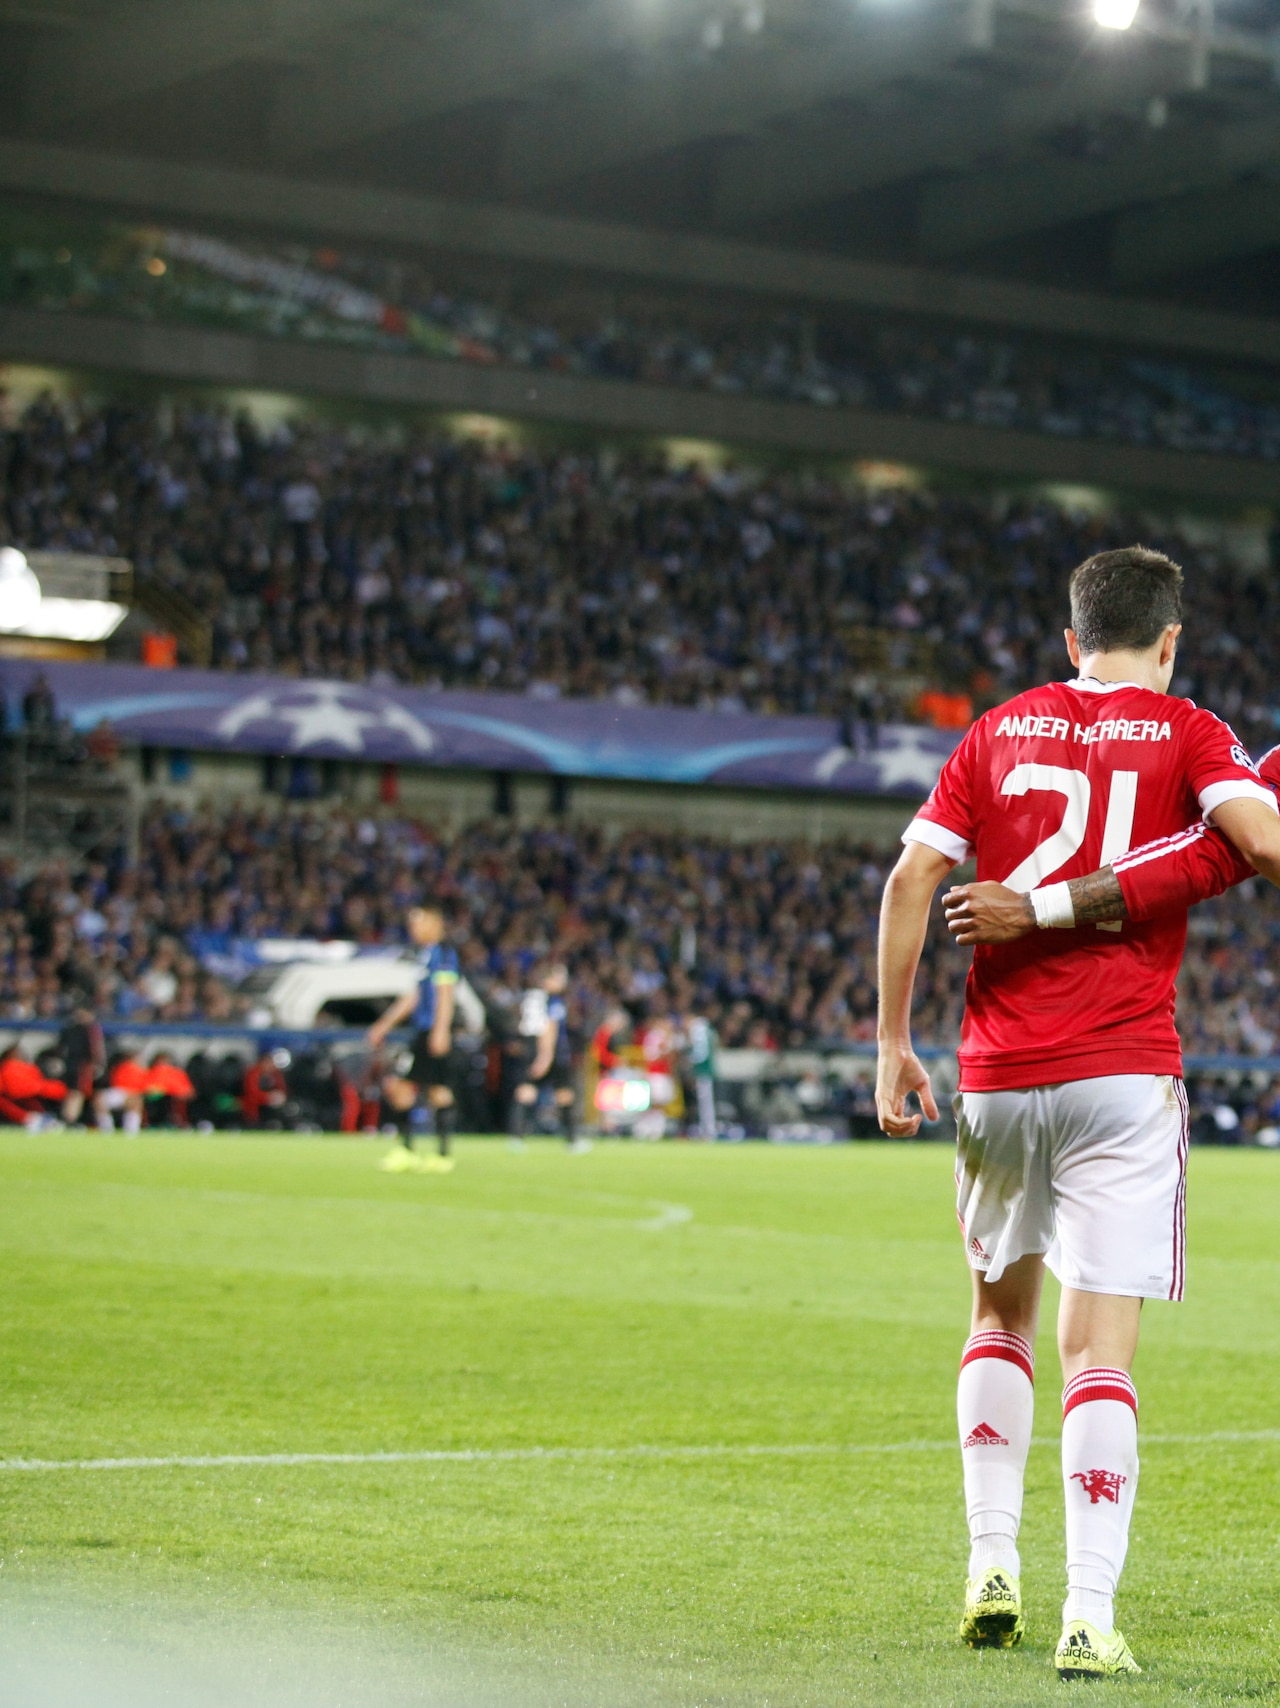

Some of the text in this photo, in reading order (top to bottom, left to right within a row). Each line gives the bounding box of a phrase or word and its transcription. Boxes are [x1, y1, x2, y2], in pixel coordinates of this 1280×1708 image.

[995, 716, 1172, 745] ANDER HERRERA
[1000, 763, 1139, 932] 21
[963, 1436, 1009, 1449] adidas
[976, 1590, 1017, 1604] adidas
